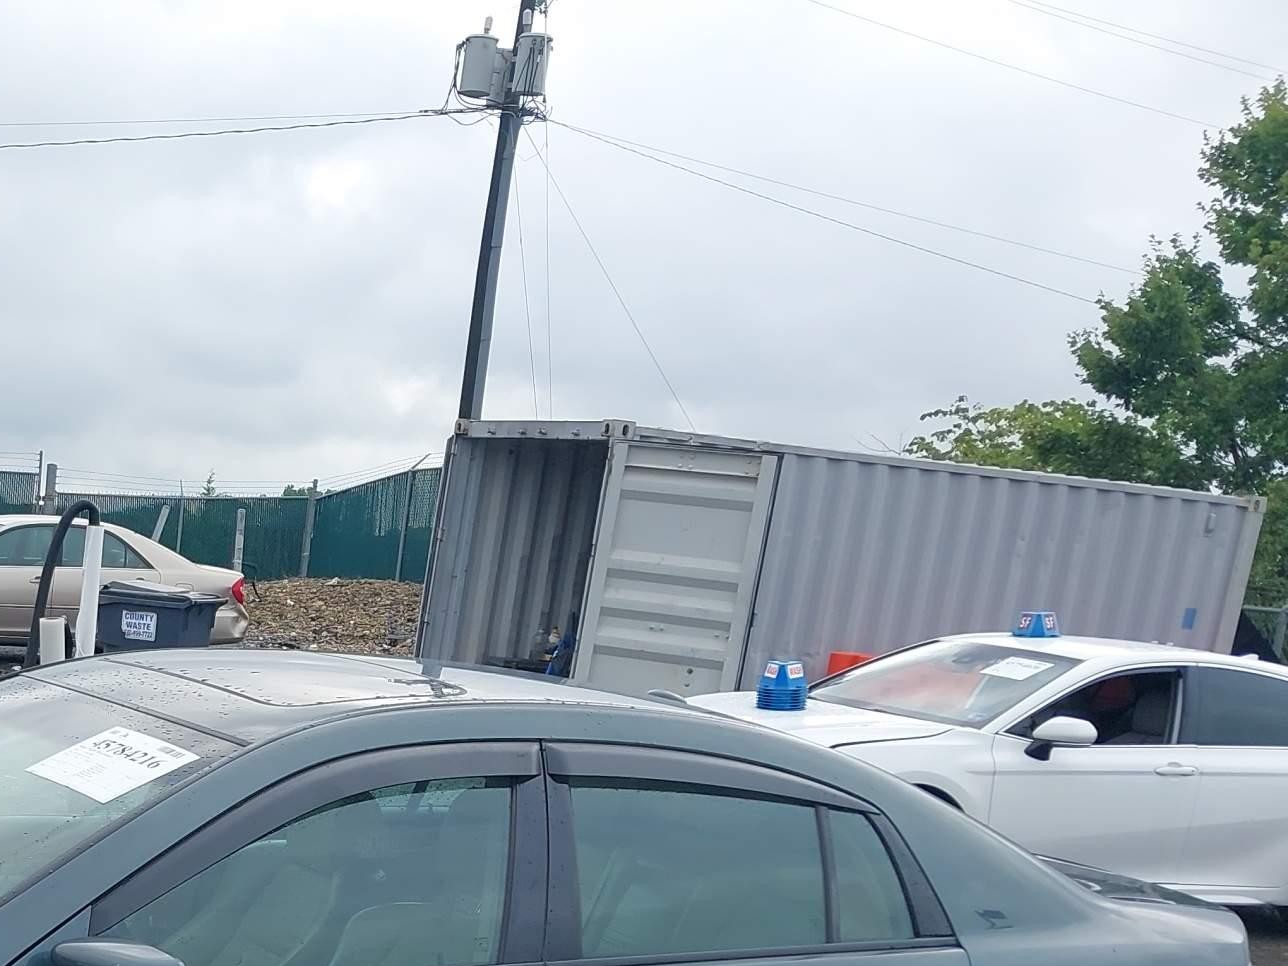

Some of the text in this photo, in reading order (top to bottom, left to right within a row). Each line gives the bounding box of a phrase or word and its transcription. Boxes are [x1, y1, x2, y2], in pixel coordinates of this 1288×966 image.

[124, 612, 154, 622] COUNTY
[125, 621, 152, 631] WASTE
[92, 739, 166, 769] 45784216
